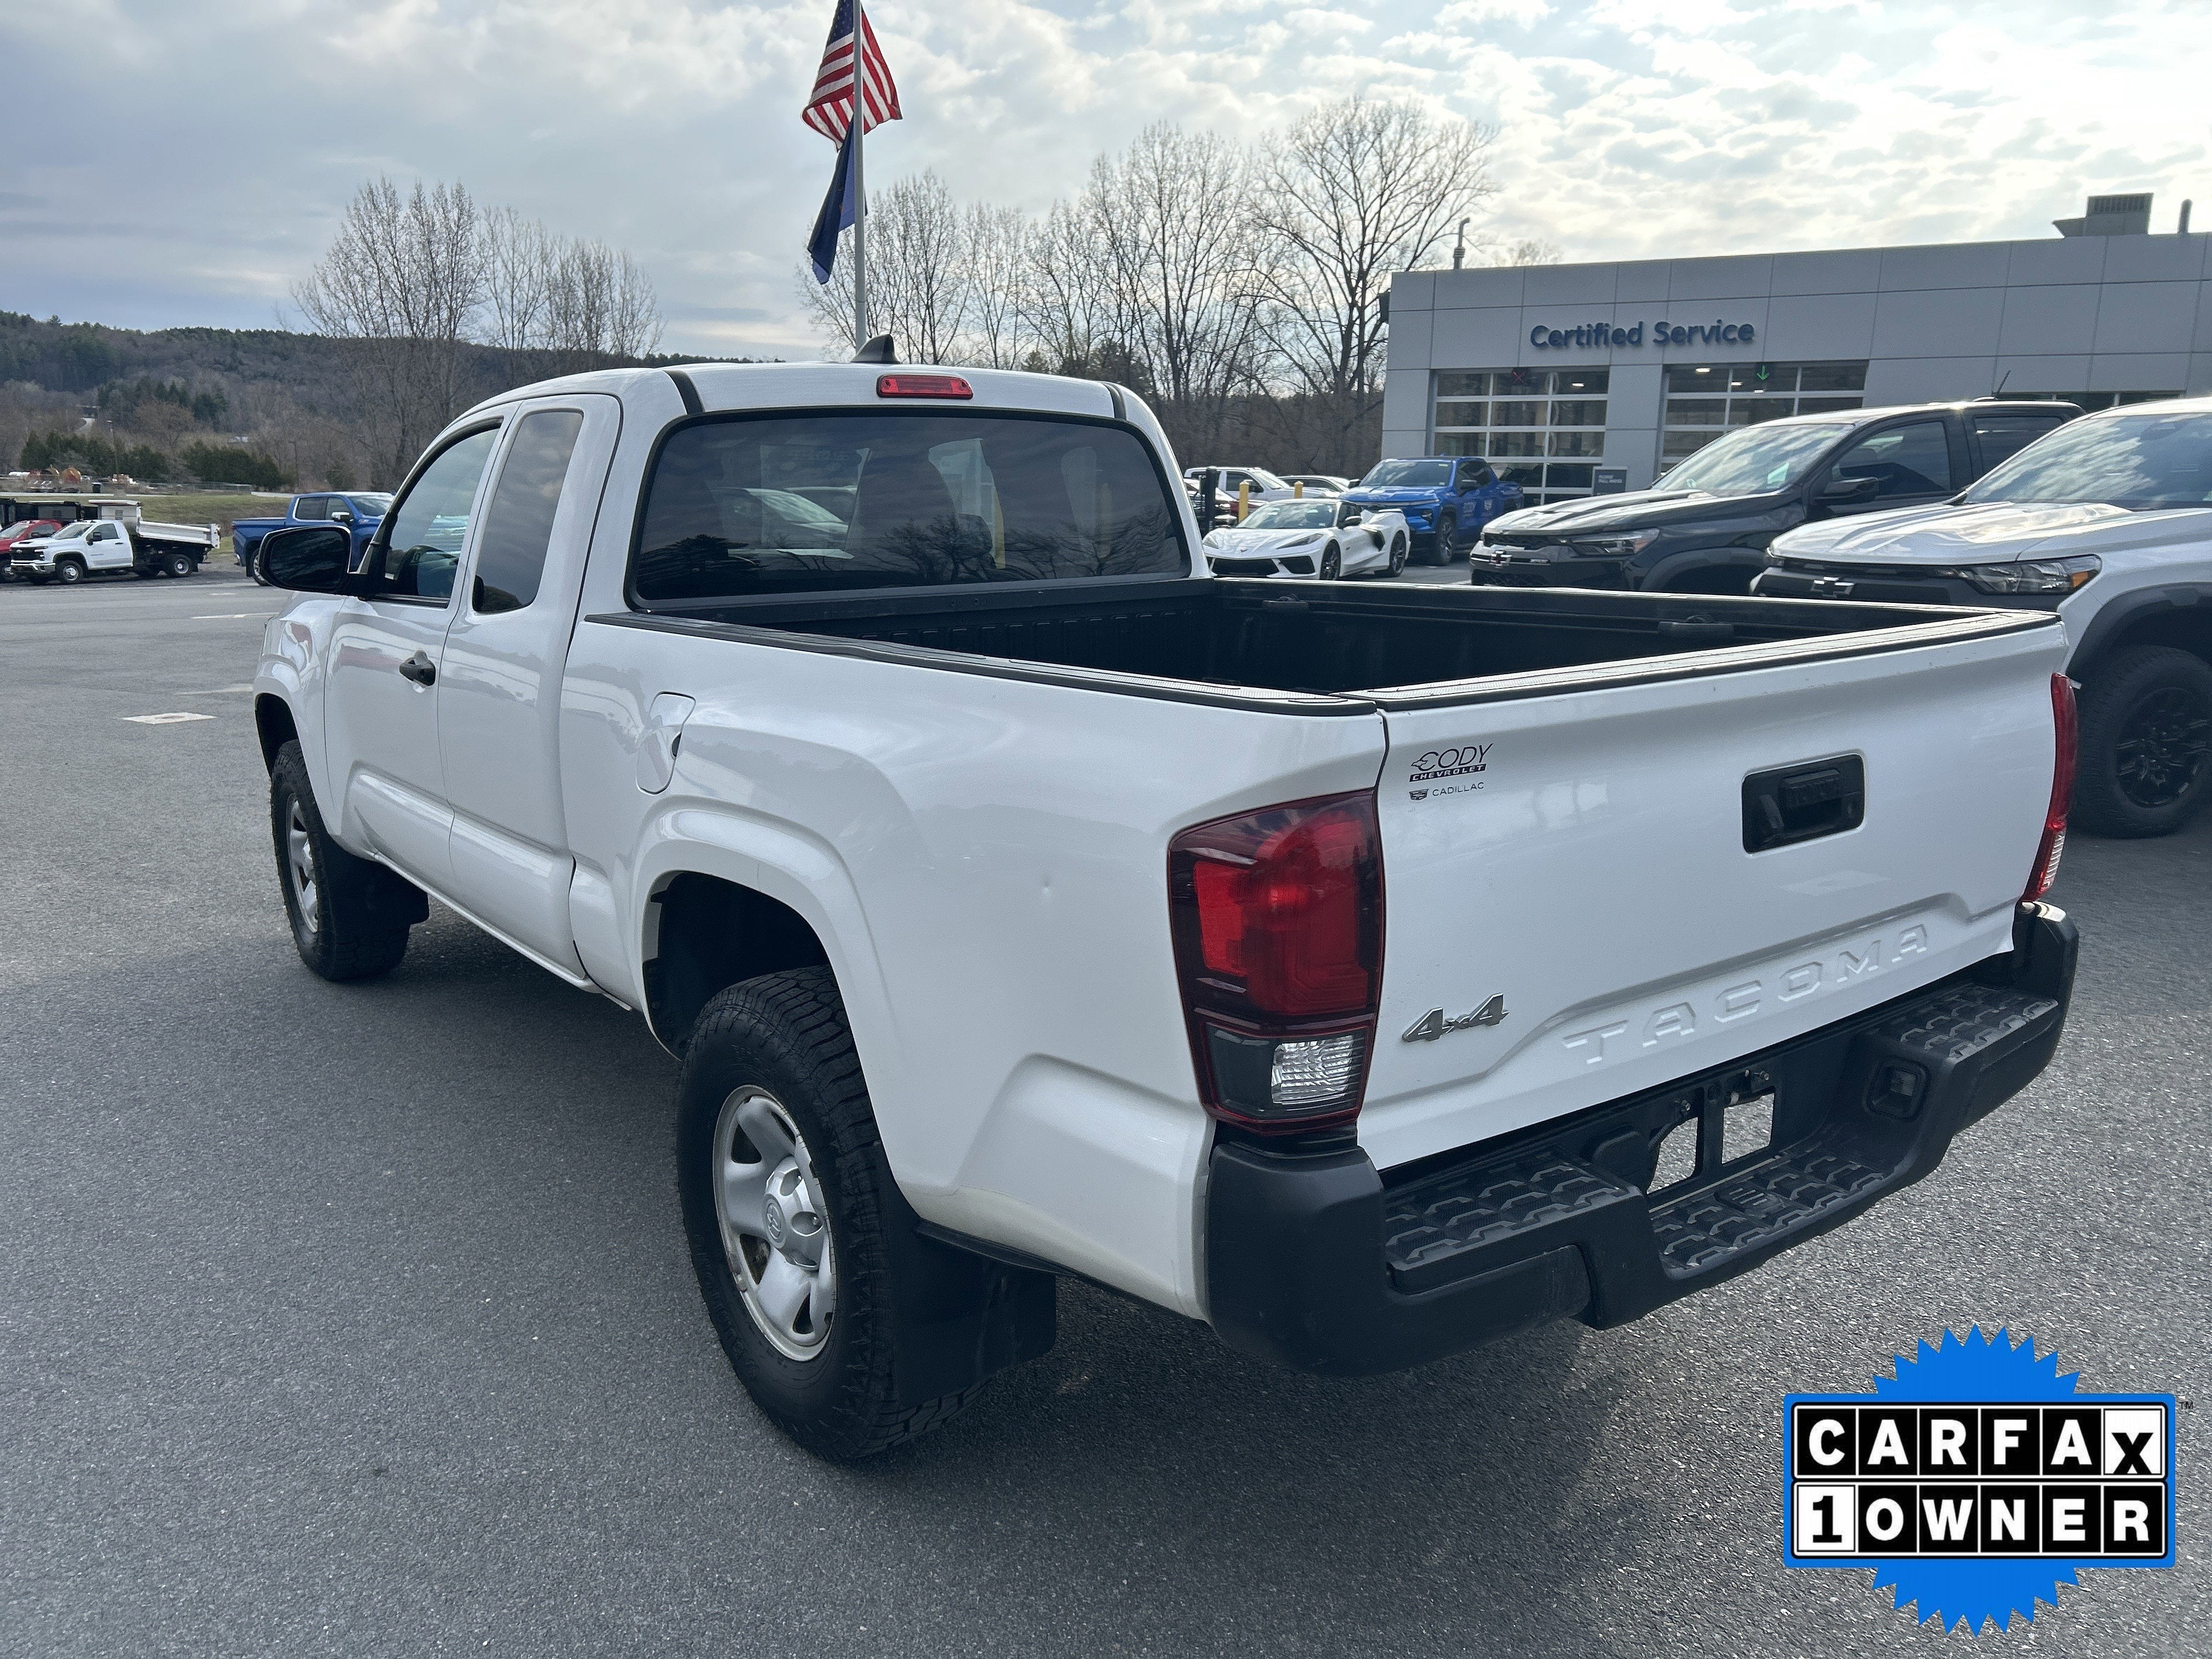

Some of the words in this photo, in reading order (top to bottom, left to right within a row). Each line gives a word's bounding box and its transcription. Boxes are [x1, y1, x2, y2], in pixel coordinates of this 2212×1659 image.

[1530, 321, 1645, 348] Certified
[1653, 319, 1755, 345] Service
[1411, 743, 1494, 771] CODY
[1412, 765, 1483, 781] CHEVROLET
[1432, 782, 1485, 796] CADILLAC
[1564, 924, 1928, 1063] TACOMA
